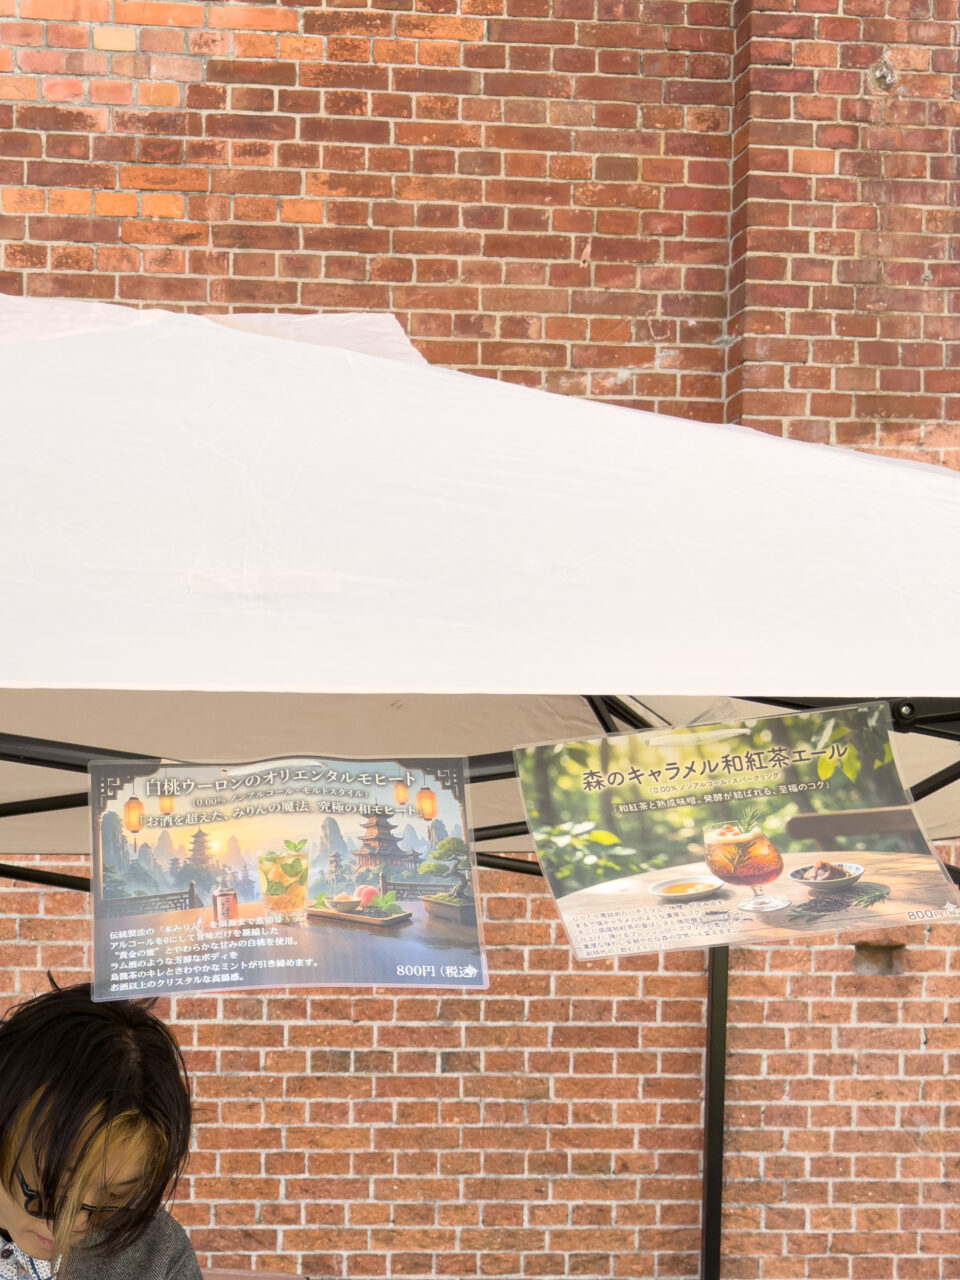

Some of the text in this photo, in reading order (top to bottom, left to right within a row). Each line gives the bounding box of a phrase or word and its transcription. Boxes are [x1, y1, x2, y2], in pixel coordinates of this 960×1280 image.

[145, 769, 417, 797] 白桃ウーロンのオリエンタルモヒート
[582, 743, 848, 791] 森のキャラメル和紅茶エール
